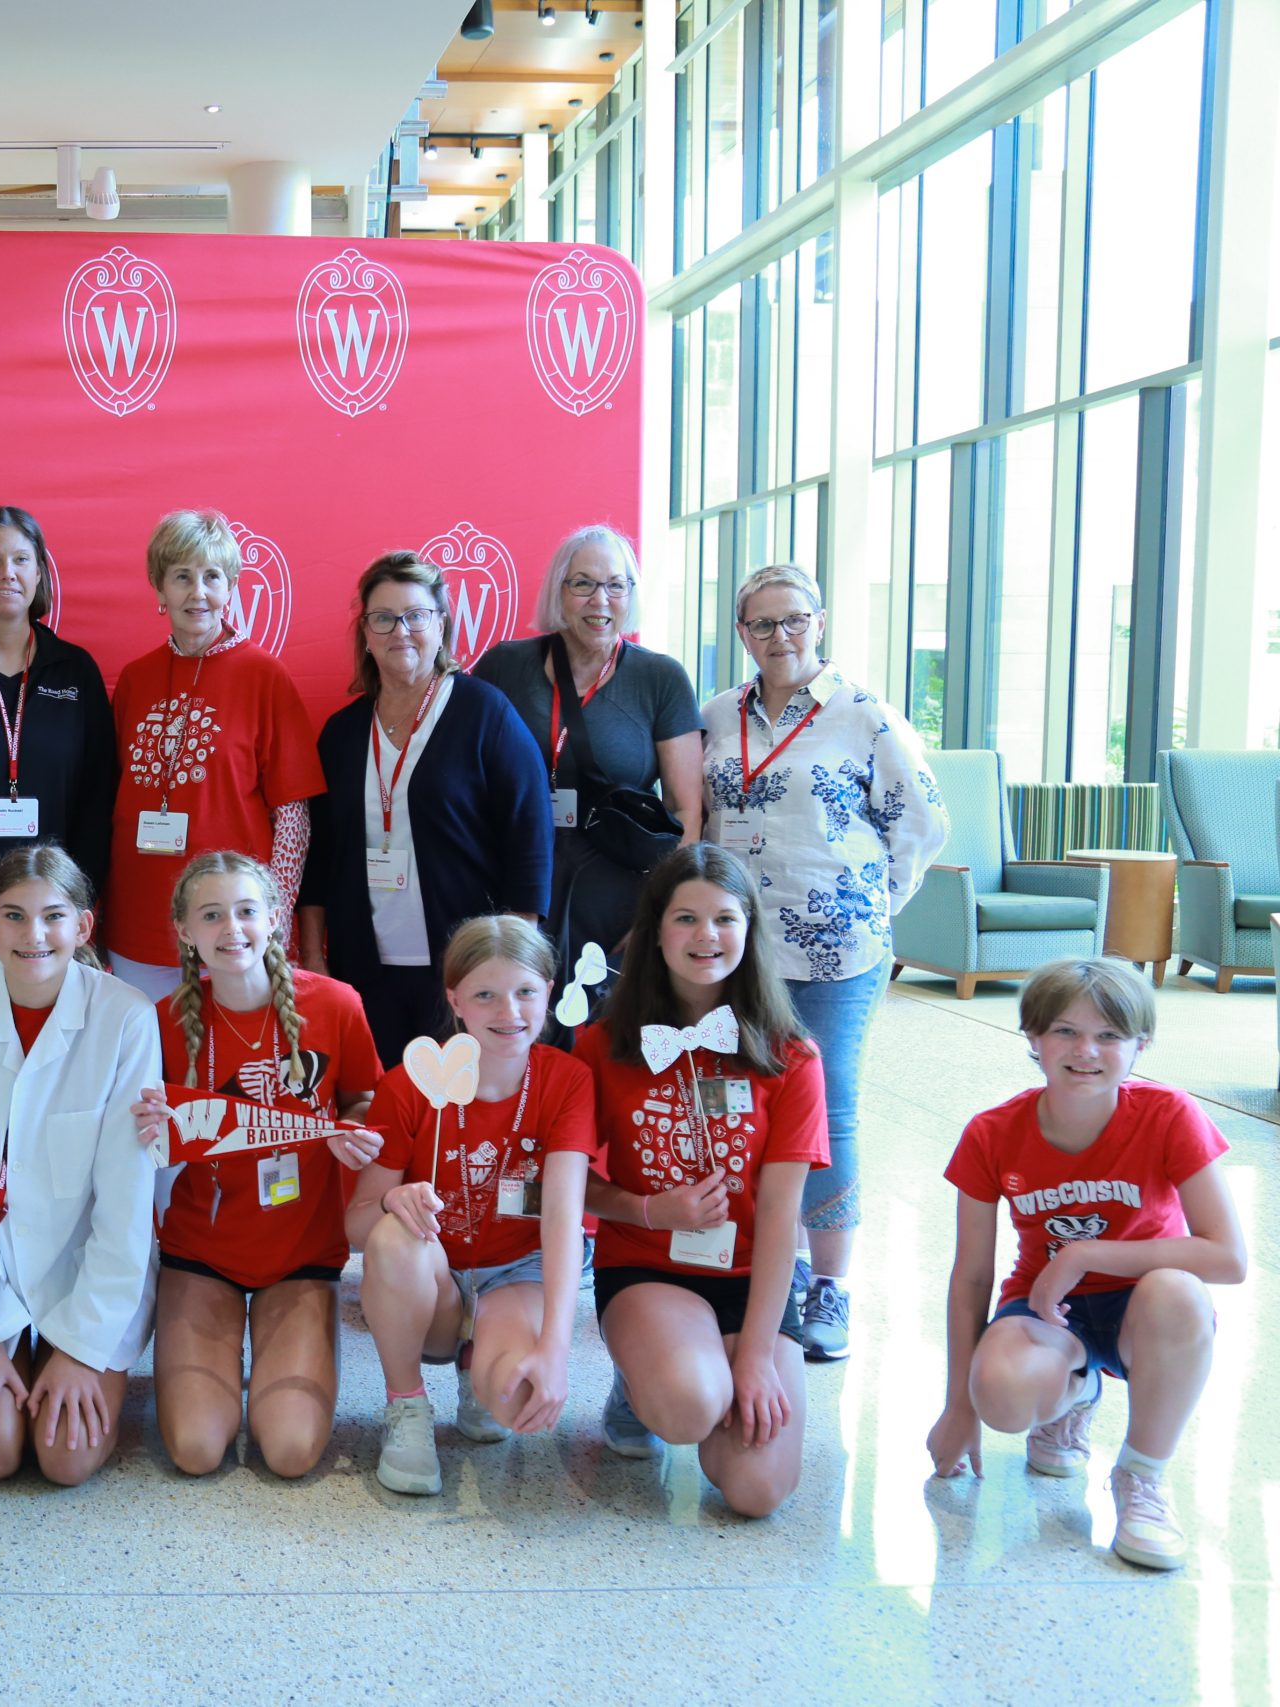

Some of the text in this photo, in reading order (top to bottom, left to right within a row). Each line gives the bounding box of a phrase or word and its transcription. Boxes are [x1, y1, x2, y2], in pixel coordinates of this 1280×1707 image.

[91, 302, 148, 377] W
[324, 304, 380, 378] W
[554, 303, 609, 378] W
[448, 578, 491, 655] W
[130, 764, 147, 773] GPU
[675, 1070, 690, 1103] WISCONSIN
[172, 1098, 227, 1144] W
[235, 1102, 335, 1129] WISCONSIN
[512, 1090, 528, 1132] ASSOCIATION
[247, 1129, 323, 1145] BADGERS
[459, 1143, 468, 1184] ASSOCIATION
[470, 1168, 492, 1185] W
[642, 1167, 665, 1179] GPU
